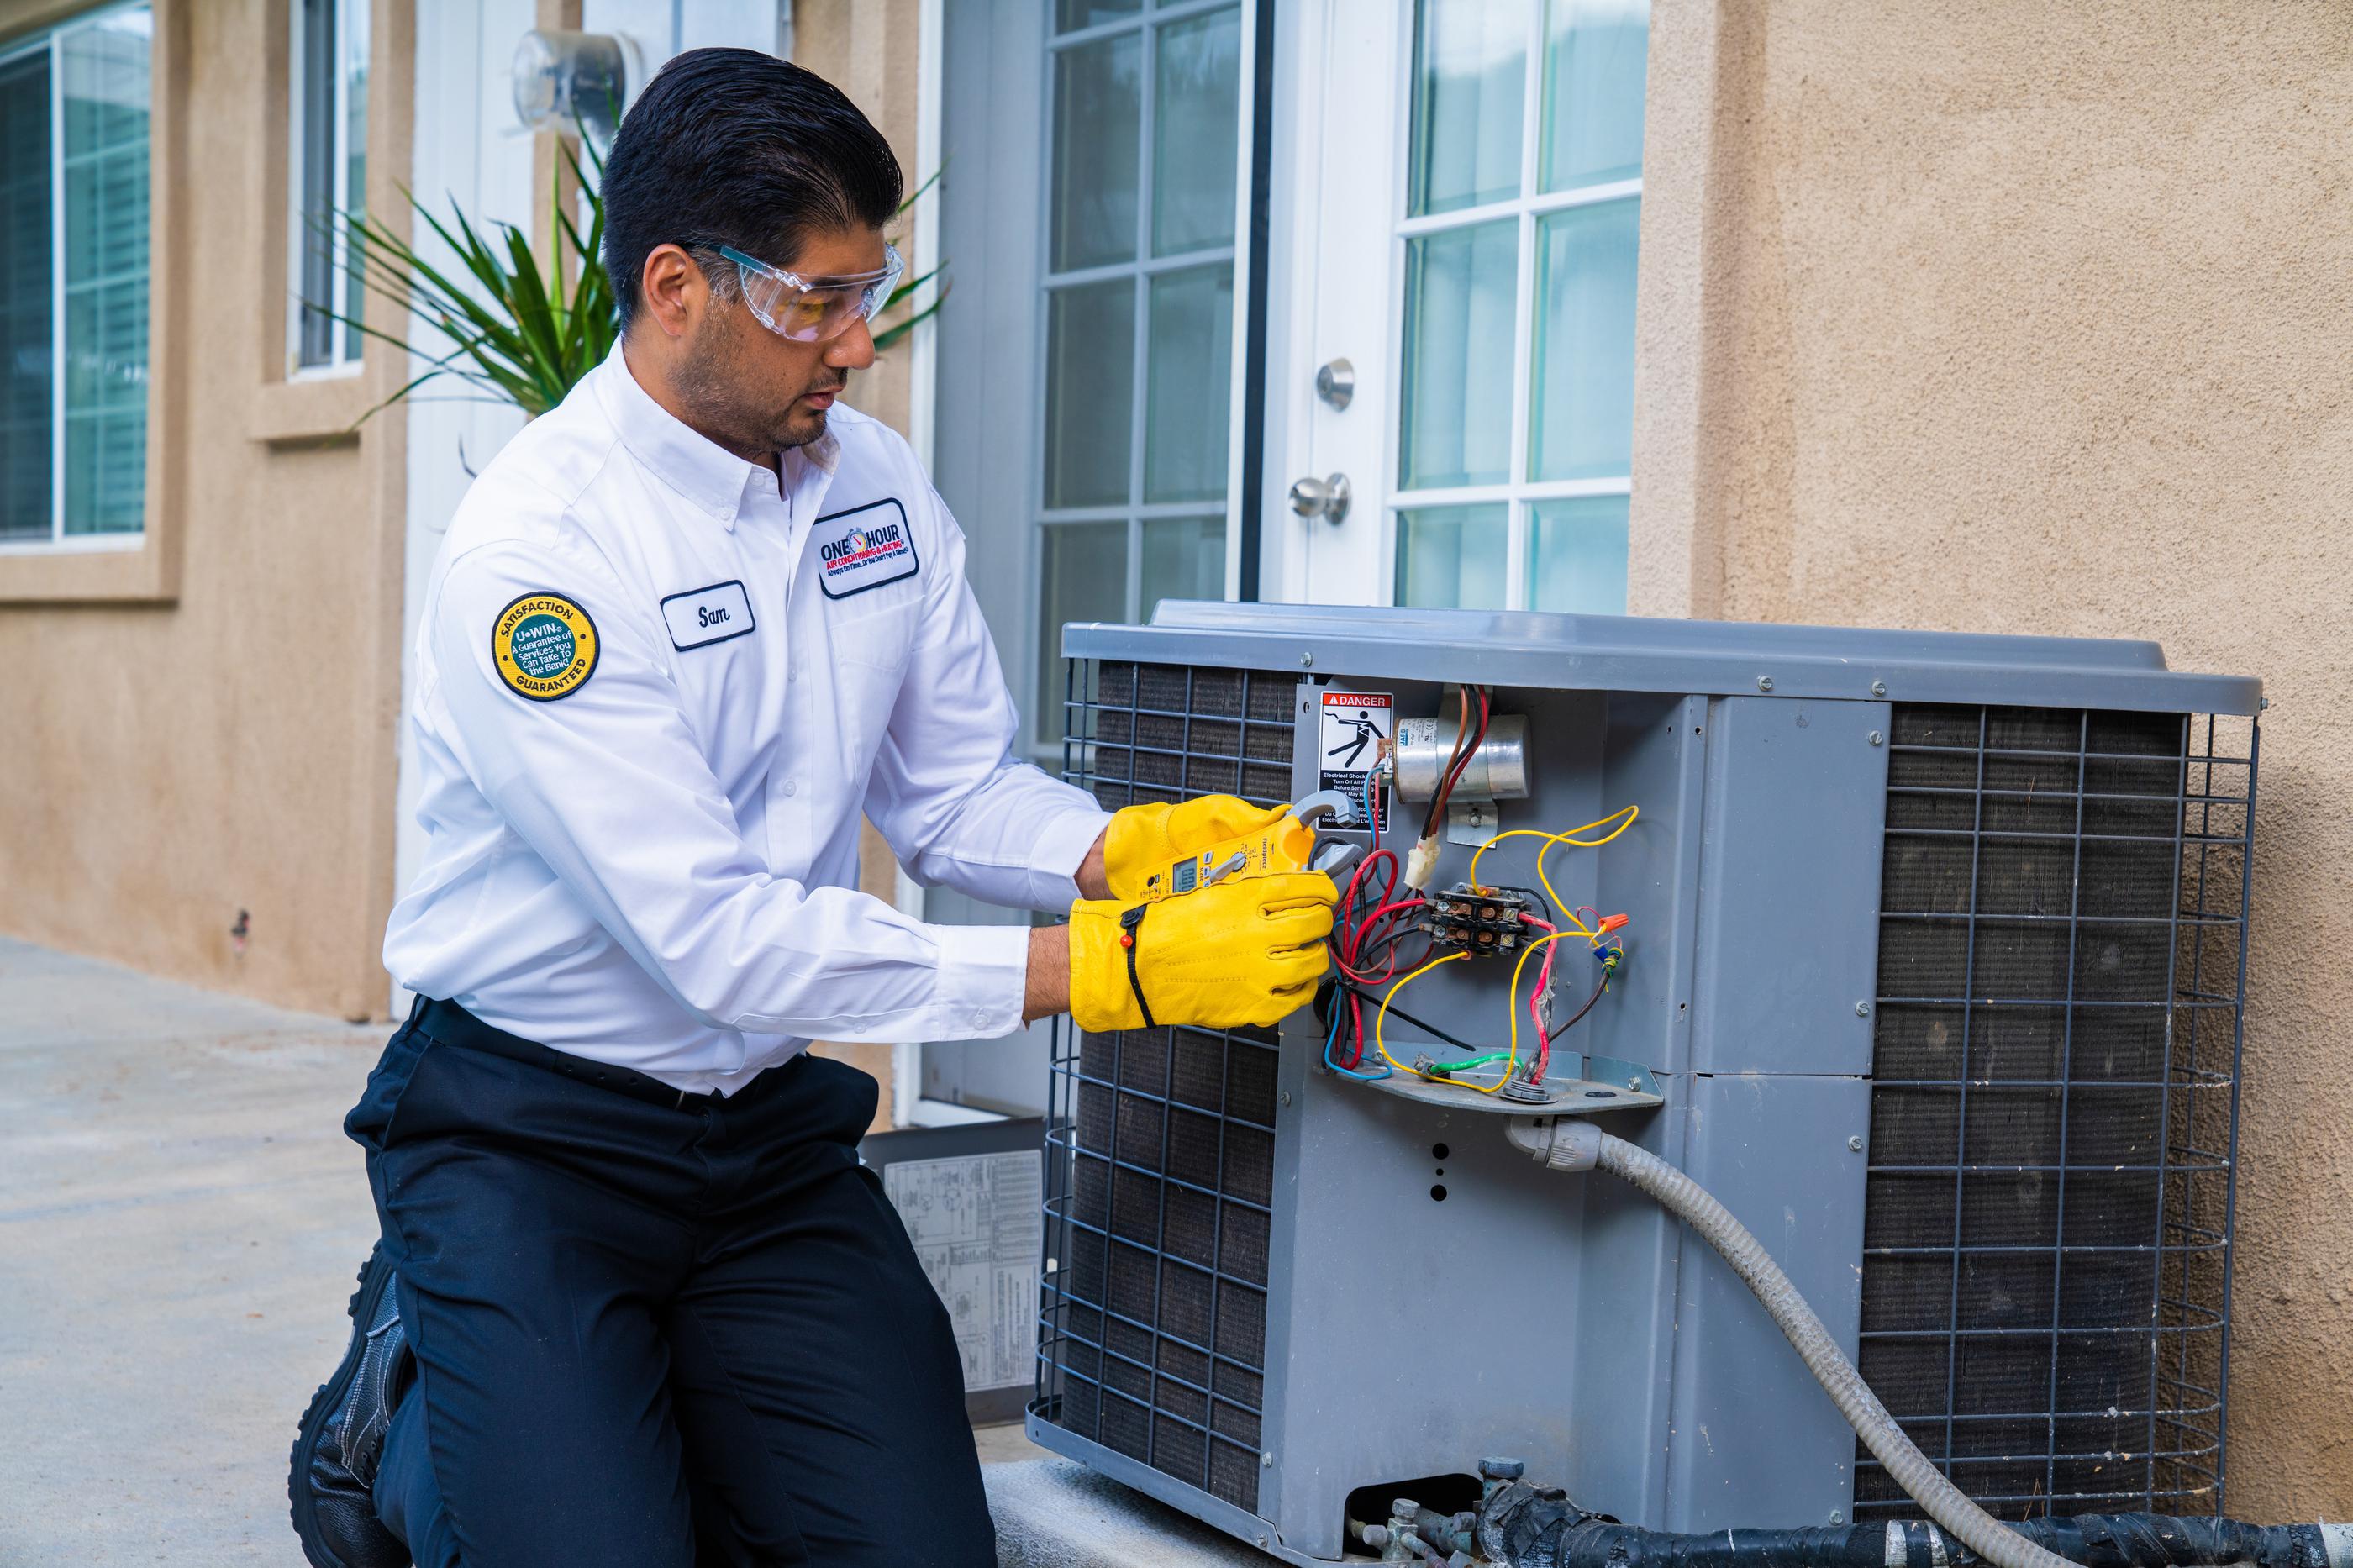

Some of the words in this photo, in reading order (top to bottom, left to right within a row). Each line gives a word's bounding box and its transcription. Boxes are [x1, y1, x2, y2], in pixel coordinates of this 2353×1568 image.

[821, 539, 850, 561] ONE
[866, 524, 900, 548] HOUR
[826, 561, 838, 570] AIR
[838, 549, 876, 566] CONDITIONING
[828, 567, 844, 577] Always
[501, 601, 574, 637] SATISFACTION
[698, 606, 730, 628] Sam
[512, 645, 518, 655] A
[518, 635, 561, 651] Guarantee
[562, 630, 571, 640] of
[519, 646, 554, 661] Services
[554, 642, 571, 652] You
[523, 660, 538, 669] Can
[529, 666, 544, 676] the
[516, 659, 586, 692] GUARANTEED
[1340, 696, 1385, 707] DANGER
